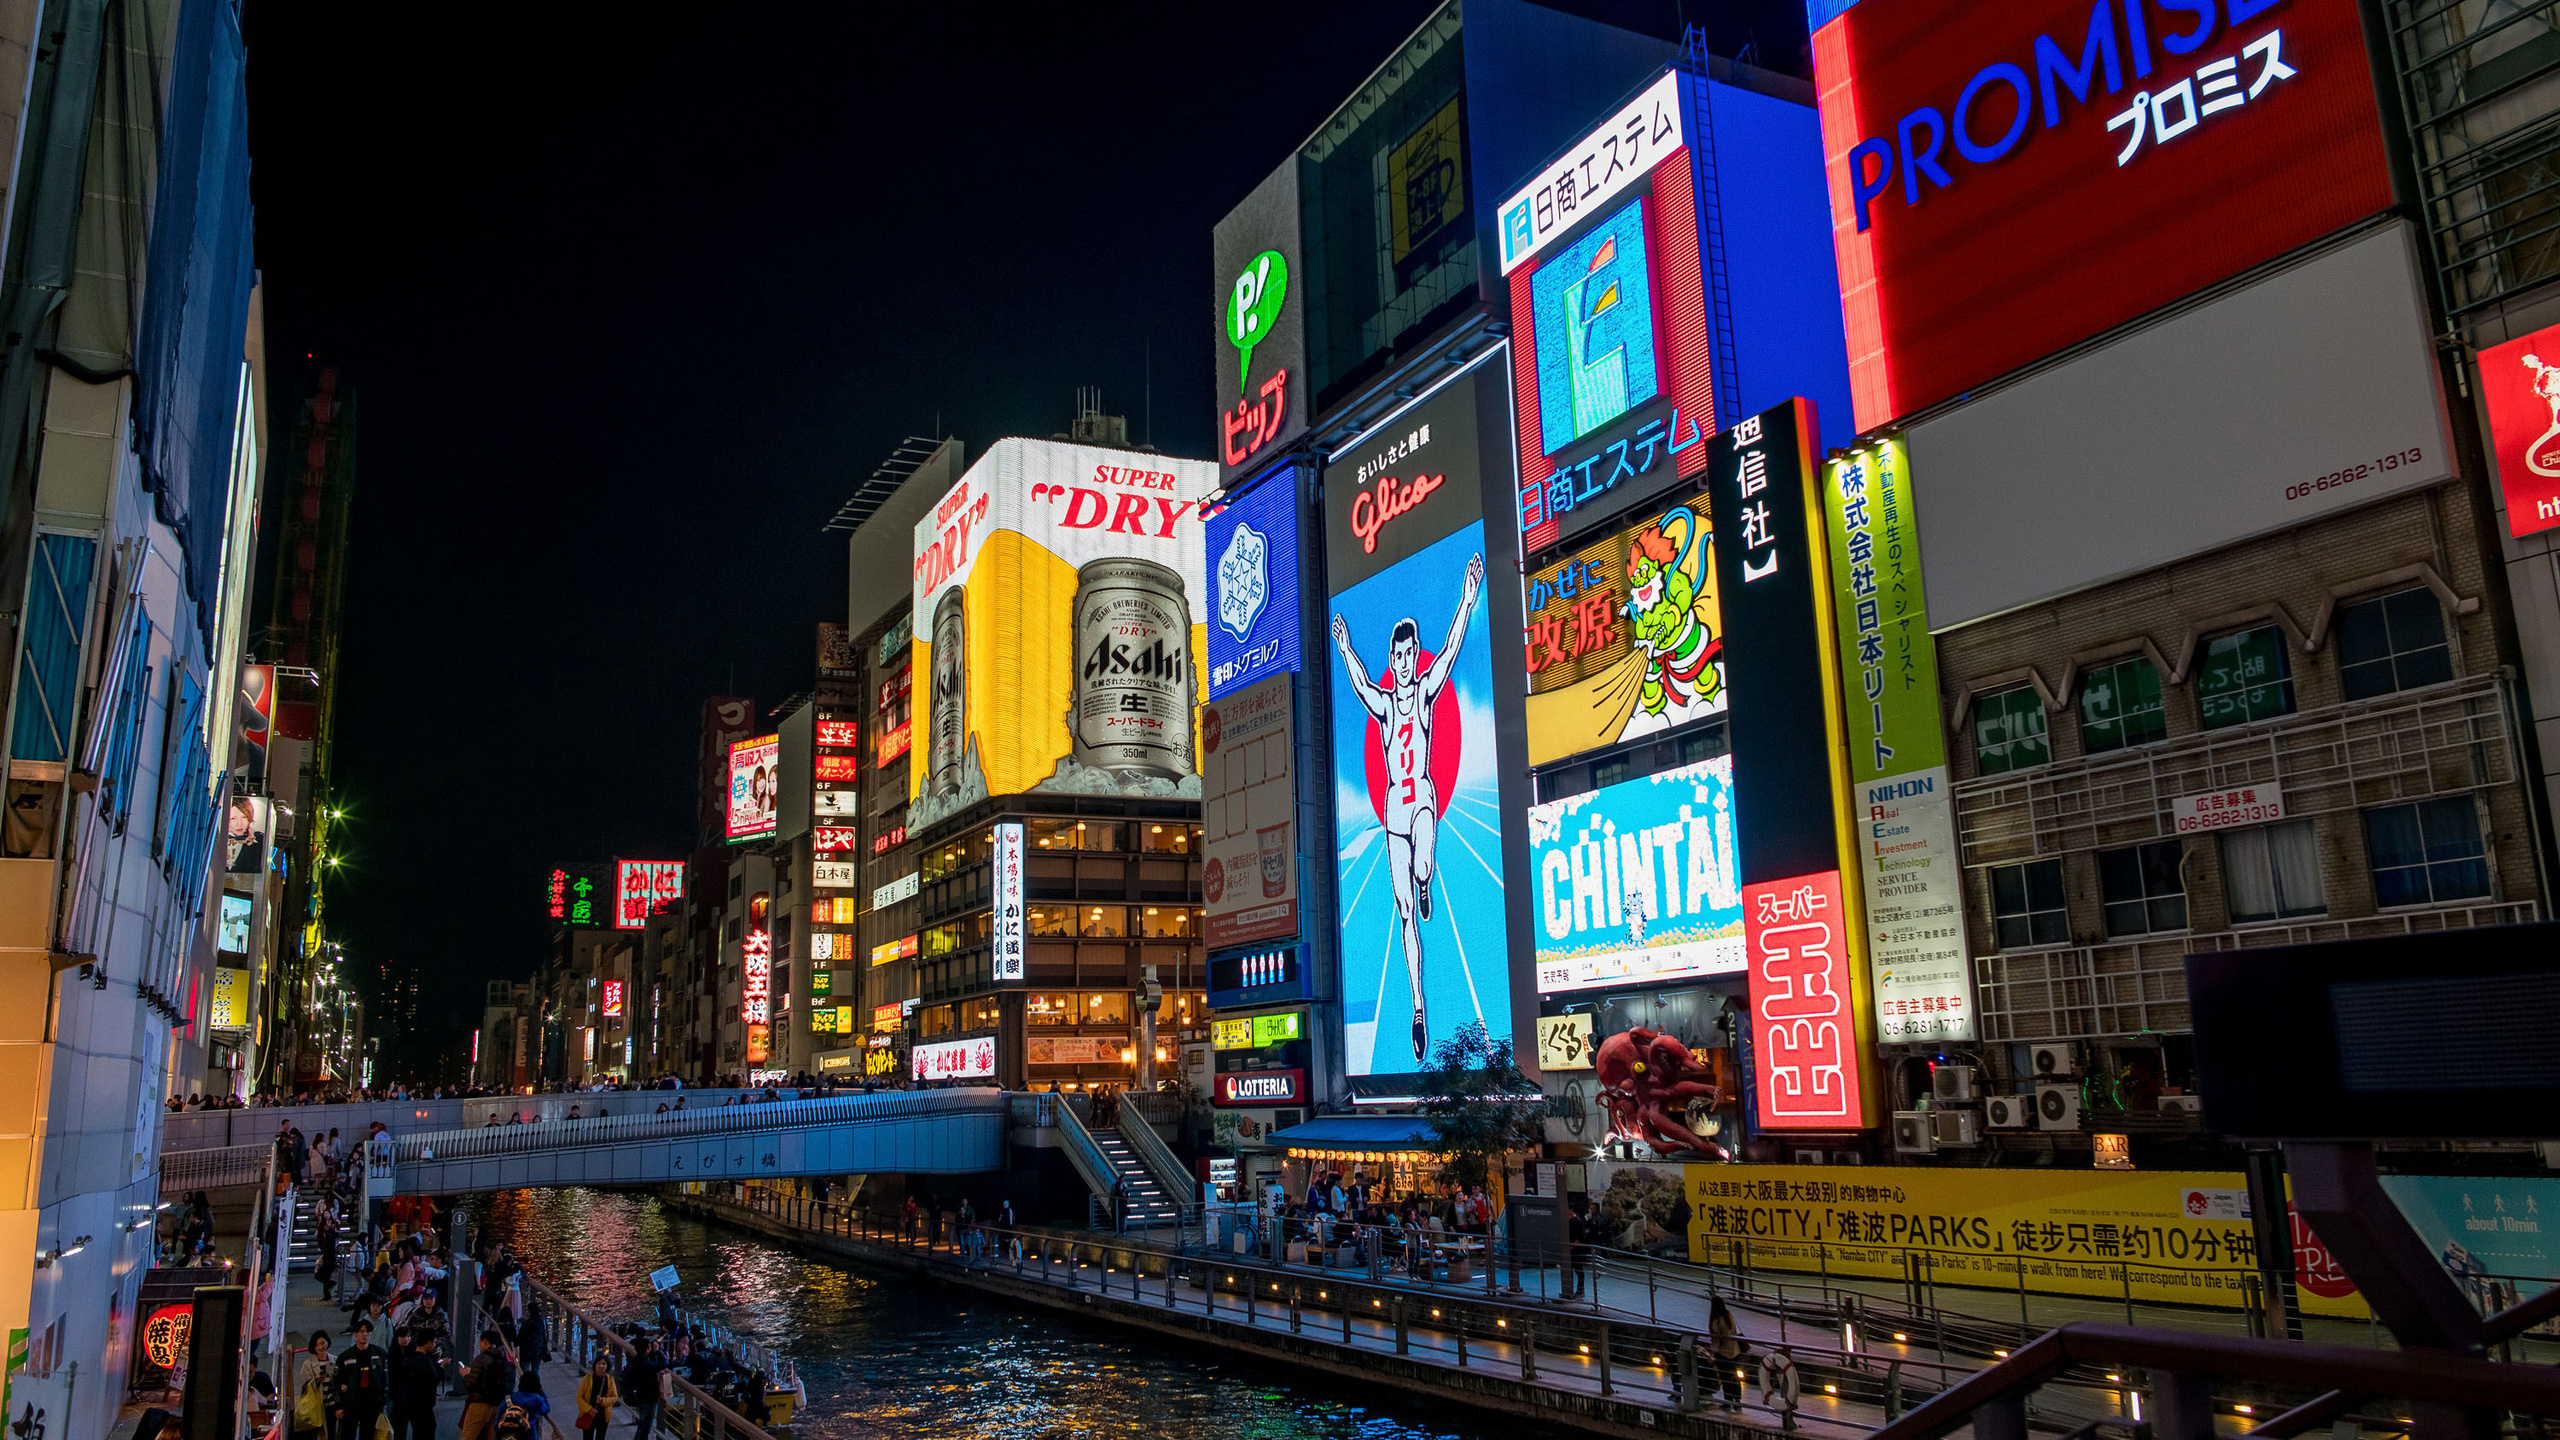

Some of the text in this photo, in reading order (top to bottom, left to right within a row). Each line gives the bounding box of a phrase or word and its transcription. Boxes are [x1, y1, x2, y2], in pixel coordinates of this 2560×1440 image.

[2107, 29, 2298, 167] プロミス
[1536, 101, 1673, 235] 日商エステム
[1224, 368, 1286, 466] ピップ
[1357, 424, 1430, 484] おいしさと健康
[1093, 464, 1176, 491] SUPER
[1519, 407, 1701, 532] 日商エステム
[2285, 447, 2422, 500] 06-6262-1313
[936, 482, 968, 530] SUPER
[1352, 474, 1444, 554] Glico
[1878, 452, 1916, 690] 不動産再生のスペシャリスト
[1528, 559, 1604, 612] かぜに
[1095, 607, 1111, 624] ASAHI
[1113, 599, 1148, 611] BREWERIES
[1151, 607, 1171, 630] LIMITED
[1841, 464, 1894, 771] 株式会社日本リート
[1524, 588, 1616, 674] 改源
[1084, 634, 1181, 685] Asahi
[1213, 639, 1278, 687] 雪印メグミルク
[933, 660, 963, 714] Asahi
[1120, 693, 1149, 713] 生
[942, 718, 951, 738] 生
[1107, 717, 1163, 730] スーパードライ
[736, 749, 764, 768] 高収入
[822, 758, 840, 767] 相席
[1122, 748, 1148, 759] 350ml
[1398, 716, 1416, 806] グリコ
[817, 767, 856, 779] ダイニング
[816, 782, 831, 790] 6F
[1869, 777, 1934, 804] NIHON
[1871, 805, 1899, 821] Real
[2195, 789, 2257, 812] 広告募集
[823, 818, 835, 826] 5F
[1873, 822, 1910, 838] Estate
[2178, 804, 2280, 832] 06-6262-1313
[816, 829, 853, 849] はや
[1874, 839, 1927, 856] Investment
[816, 866, 851, 880] 白木屋
[1007, 847, 1018, 898] 本場の味
[1874, 856, 1931, 872] Technology
[624, 868, 677, 894] かに
[1877, 871, 1918, 887] SERVICE
[1879, 882, 1928, 898] PROVIDER
[550, 869, 565, 918] お好み焼
[573, 877, 593, 919] 千房
[1757, 885, 1827, 924] スーパー
[1005, 904, 1021, 974] かに道楽
[1892, 927, 1957, 943] 全日本不動産協会
[742, 929, 771, 1024] 大阪王将
[604, 986, 613, 1007] ドラッグ
[612, 983, 621, 1003] ツルハ
[1883, 995, 1962, 1016] 広告主募集中
[812, 1021, 837, 1032] ドンキー
[813, 1011, 835, 1022] びっくり
[1884, 1018, 1964, 1036] 06-6281-1717
[1548, 1022, 1582, 1061] くくる
[1728, 1012, 1737, 1048] 2F
[936, 1048, 967, 1072] かに道楽
[1238, 1077, 1288, 1096] LOTTERIA
[2094, 1137, 2128, 1152] BAR
[673, 1154, 776, 1170] えびす橋
[2466, 1215, 2541, 1233] about 10min.
[1778, 1245, 1799, 1257] center
[1802, 1247, 1808, 1257] in
[1972, 1258, 1980, 1270] is
[2031, 1263, 2053, 1276] walk
[2056, 1265, 2078, 1278] from
[2081, 1266, 2106, 1280] here!
[2110, 1267, 2126, 1281] We
[2129, 1271, 2188, 1287] correspond
[2190, 1273, 2201, 1286] to
[2204, 1274, 2222, 1288] the
